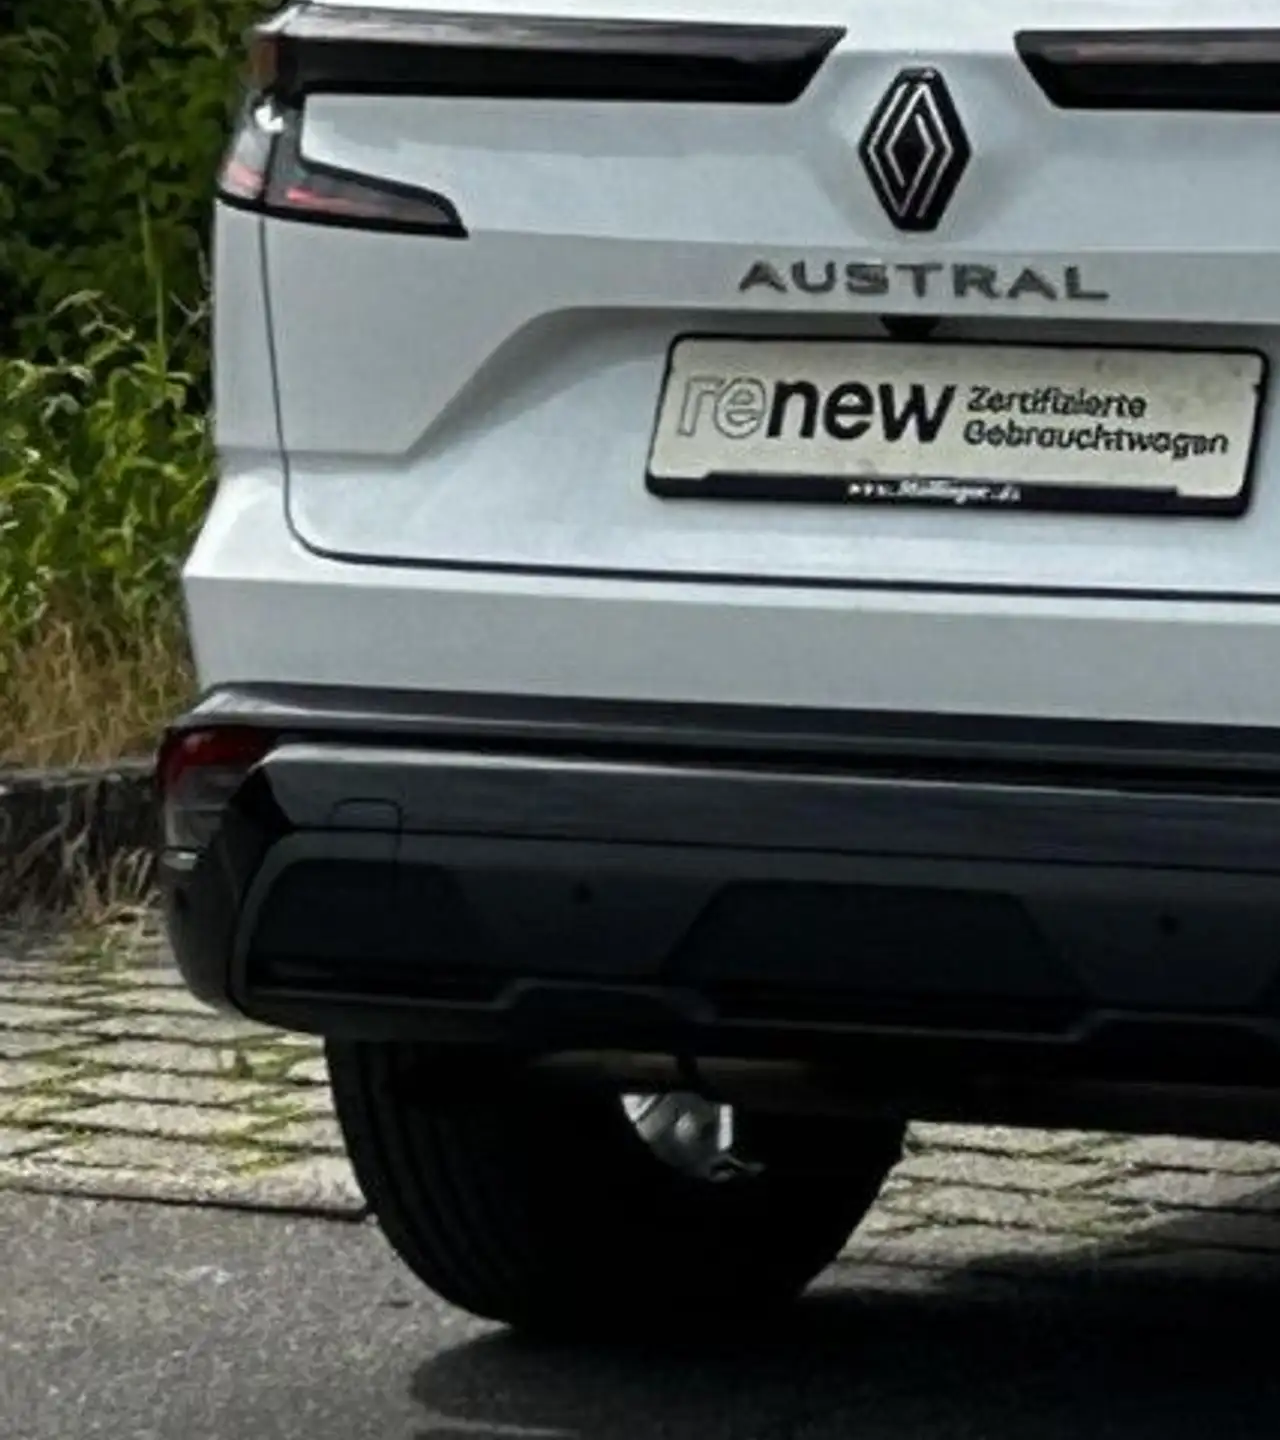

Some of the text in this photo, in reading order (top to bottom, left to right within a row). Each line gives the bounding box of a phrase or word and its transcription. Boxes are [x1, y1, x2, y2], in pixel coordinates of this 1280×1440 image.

[738, 260, 1110, 301] AUSTRAL
[676, 375, 957, 442] renew
[965, 385, 1148, 418] Zertifizierte
[963, 419, 1229, 458] Gebrauchtwagen
